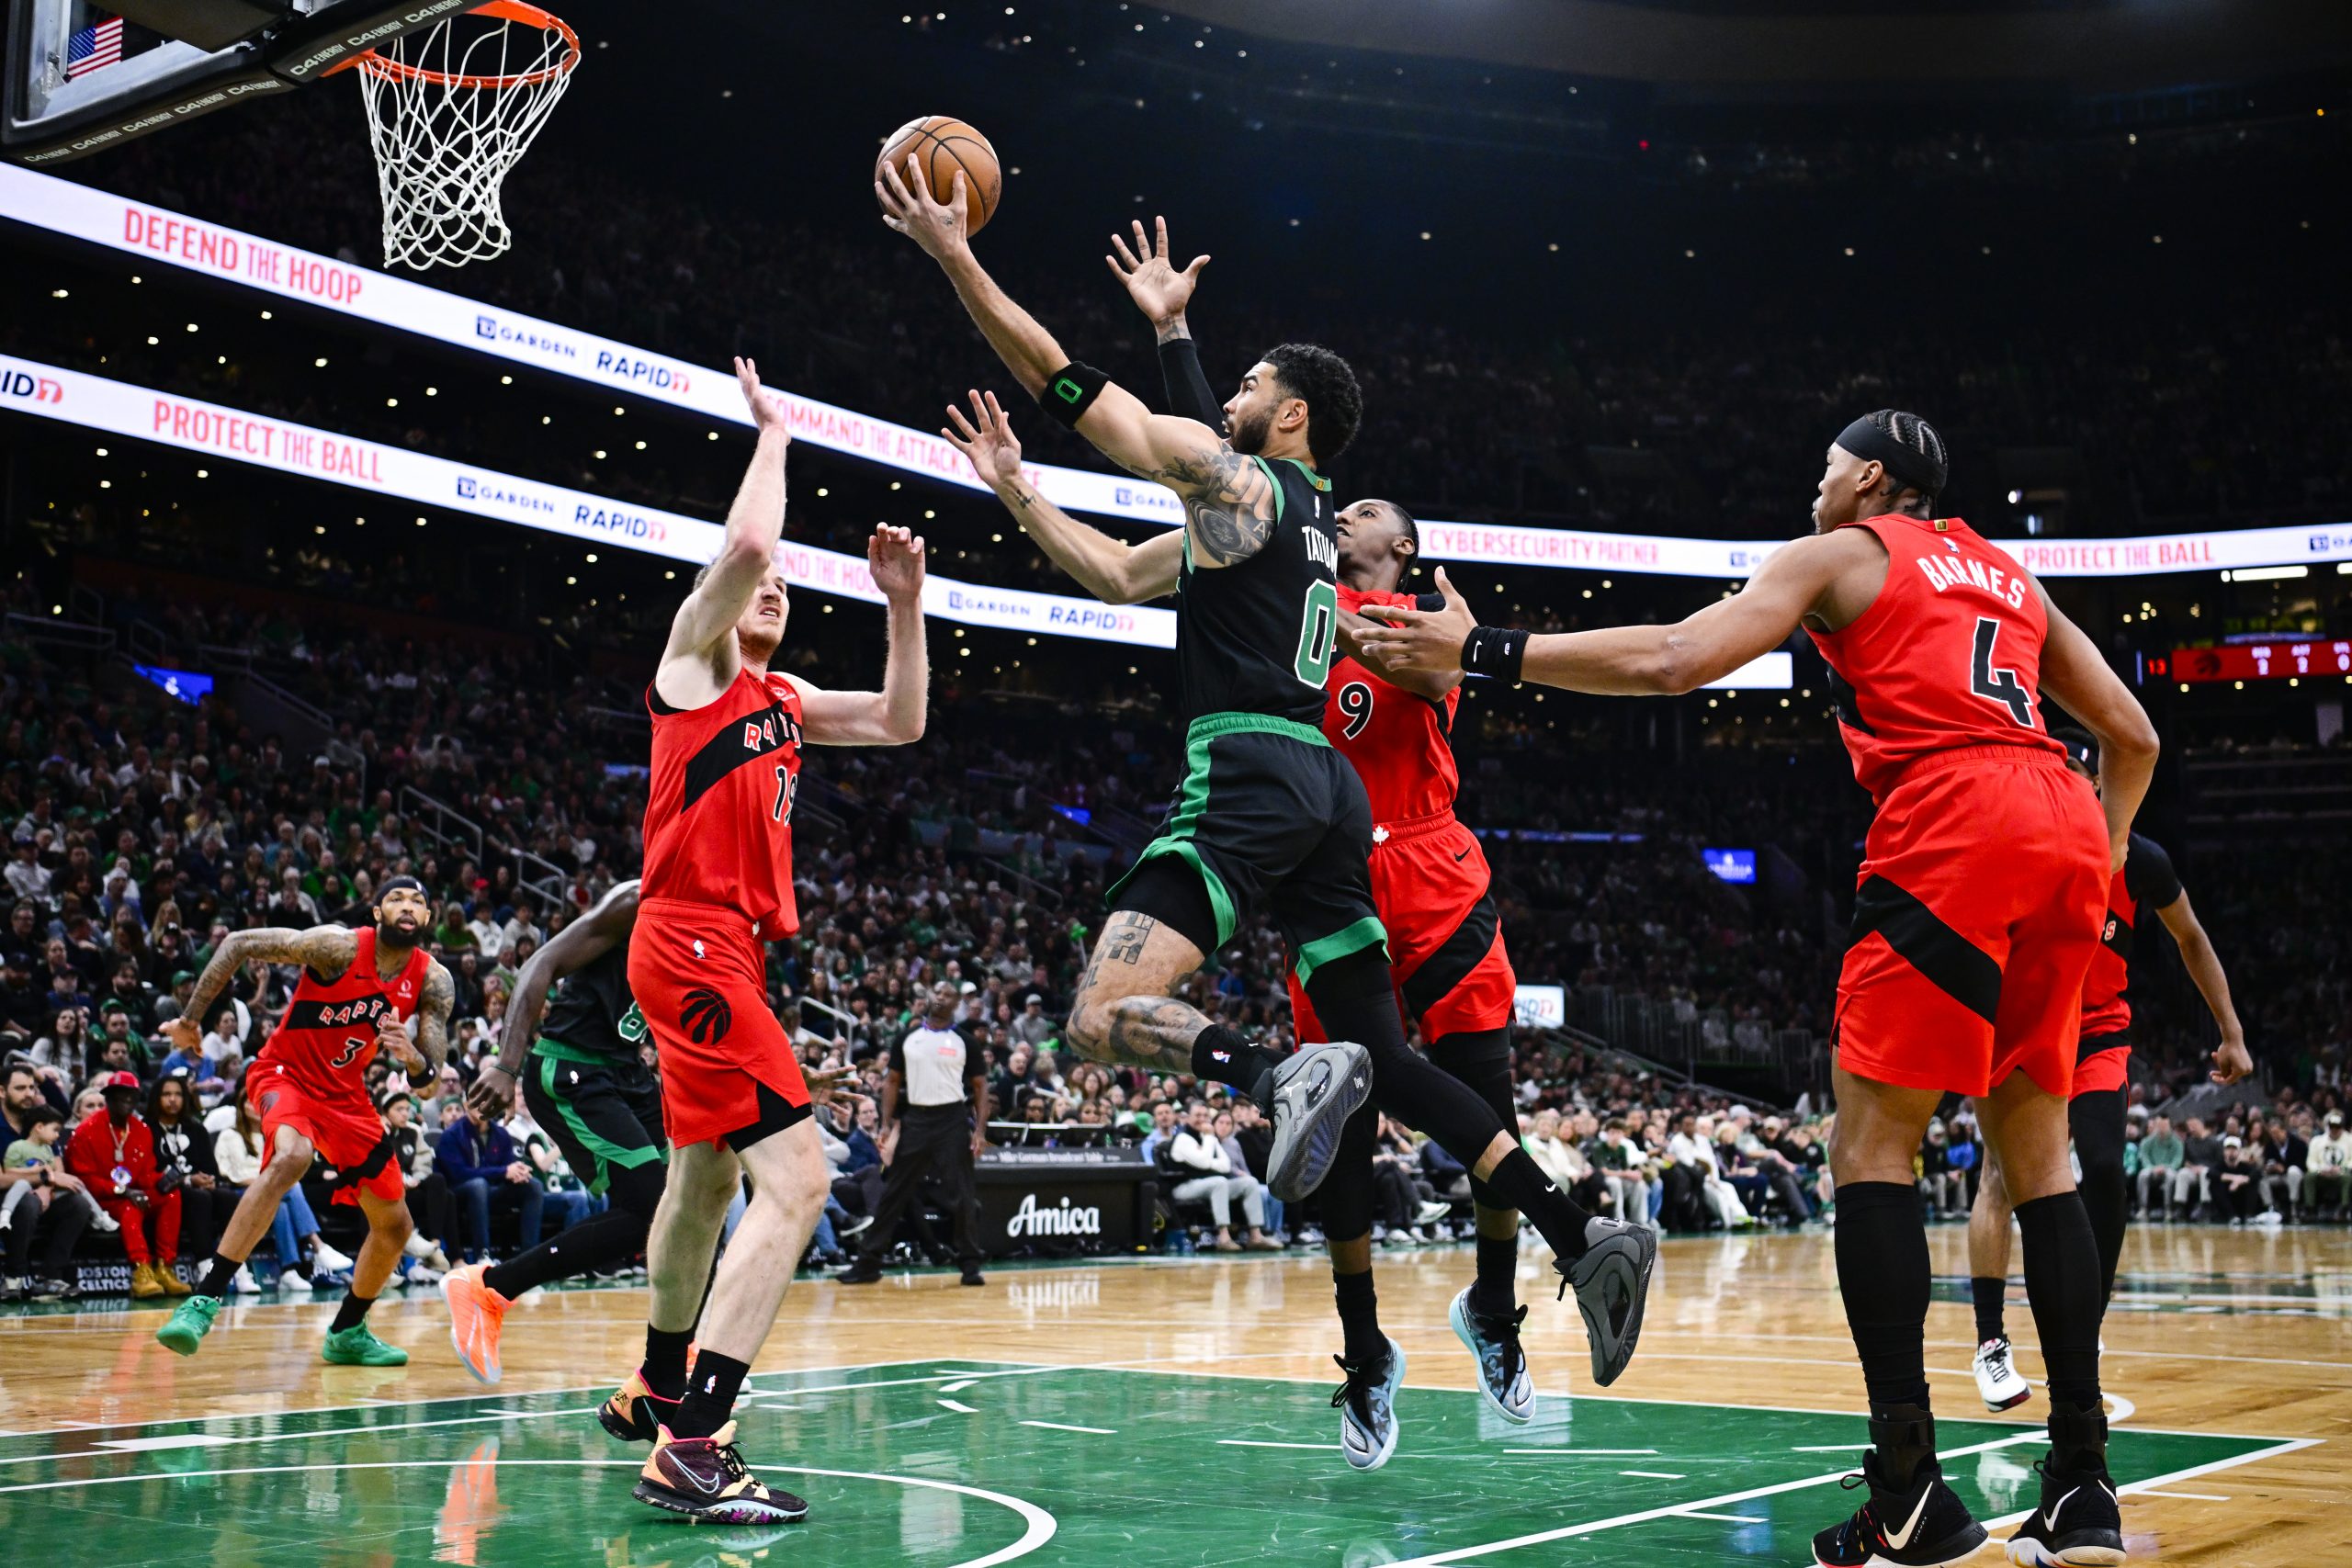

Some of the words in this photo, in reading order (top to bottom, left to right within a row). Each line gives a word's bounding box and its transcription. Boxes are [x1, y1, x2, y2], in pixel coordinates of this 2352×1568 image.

[404, 8, 434, 23] C4
[347, 32, 376, 46] C4
[370, 19, 404, 38] ENERGY
[289, 60, 319, 76] C4
[316, 43, 347, 62] ENERGY
[228, 84, 255, 96] C4
[175, 102, 201, 114] C4
[122, 119, 149, 132] C4
[72, 137, 96, 150] C4
[124, 208, 238, 271] DEFEND
[247, 242, 282, 285] THE
[288, 256, 363, 304] HOOP
[500, 326, 577, 358] GARDEN
[153, 400, 275, 457] PROTECT
[282, 428, 316, 468] THE
[322, 440, 384, 483] BALL
[870, 425, 891, 457] THE
[896, 433, 961, 477] ATTACK
[480, 486, 555, 513] GARDEN
[1429, 528, 1591, 562] CYBERSECURITY
[1598, 539, 1659, 566] PARTNER
[2023, 545, 2116, 570] PROTECT
[2159, 539, 2216, 565] BALL
[1917, 554, 2027, 609] BARNES
[965, 598, 1031, 616] GARDEN
[1295, 578, 1338, 689] 0
[1971, 615, 2035, 728] 4
[1339, 682, 1374, 740] 9
[773, 765, 798, 827] 19
[331, 1036, 367, 1068] 3
[1007, 1193, 1101, 1238] Amica
[78, 1278, 131, 1292] CELTICS
